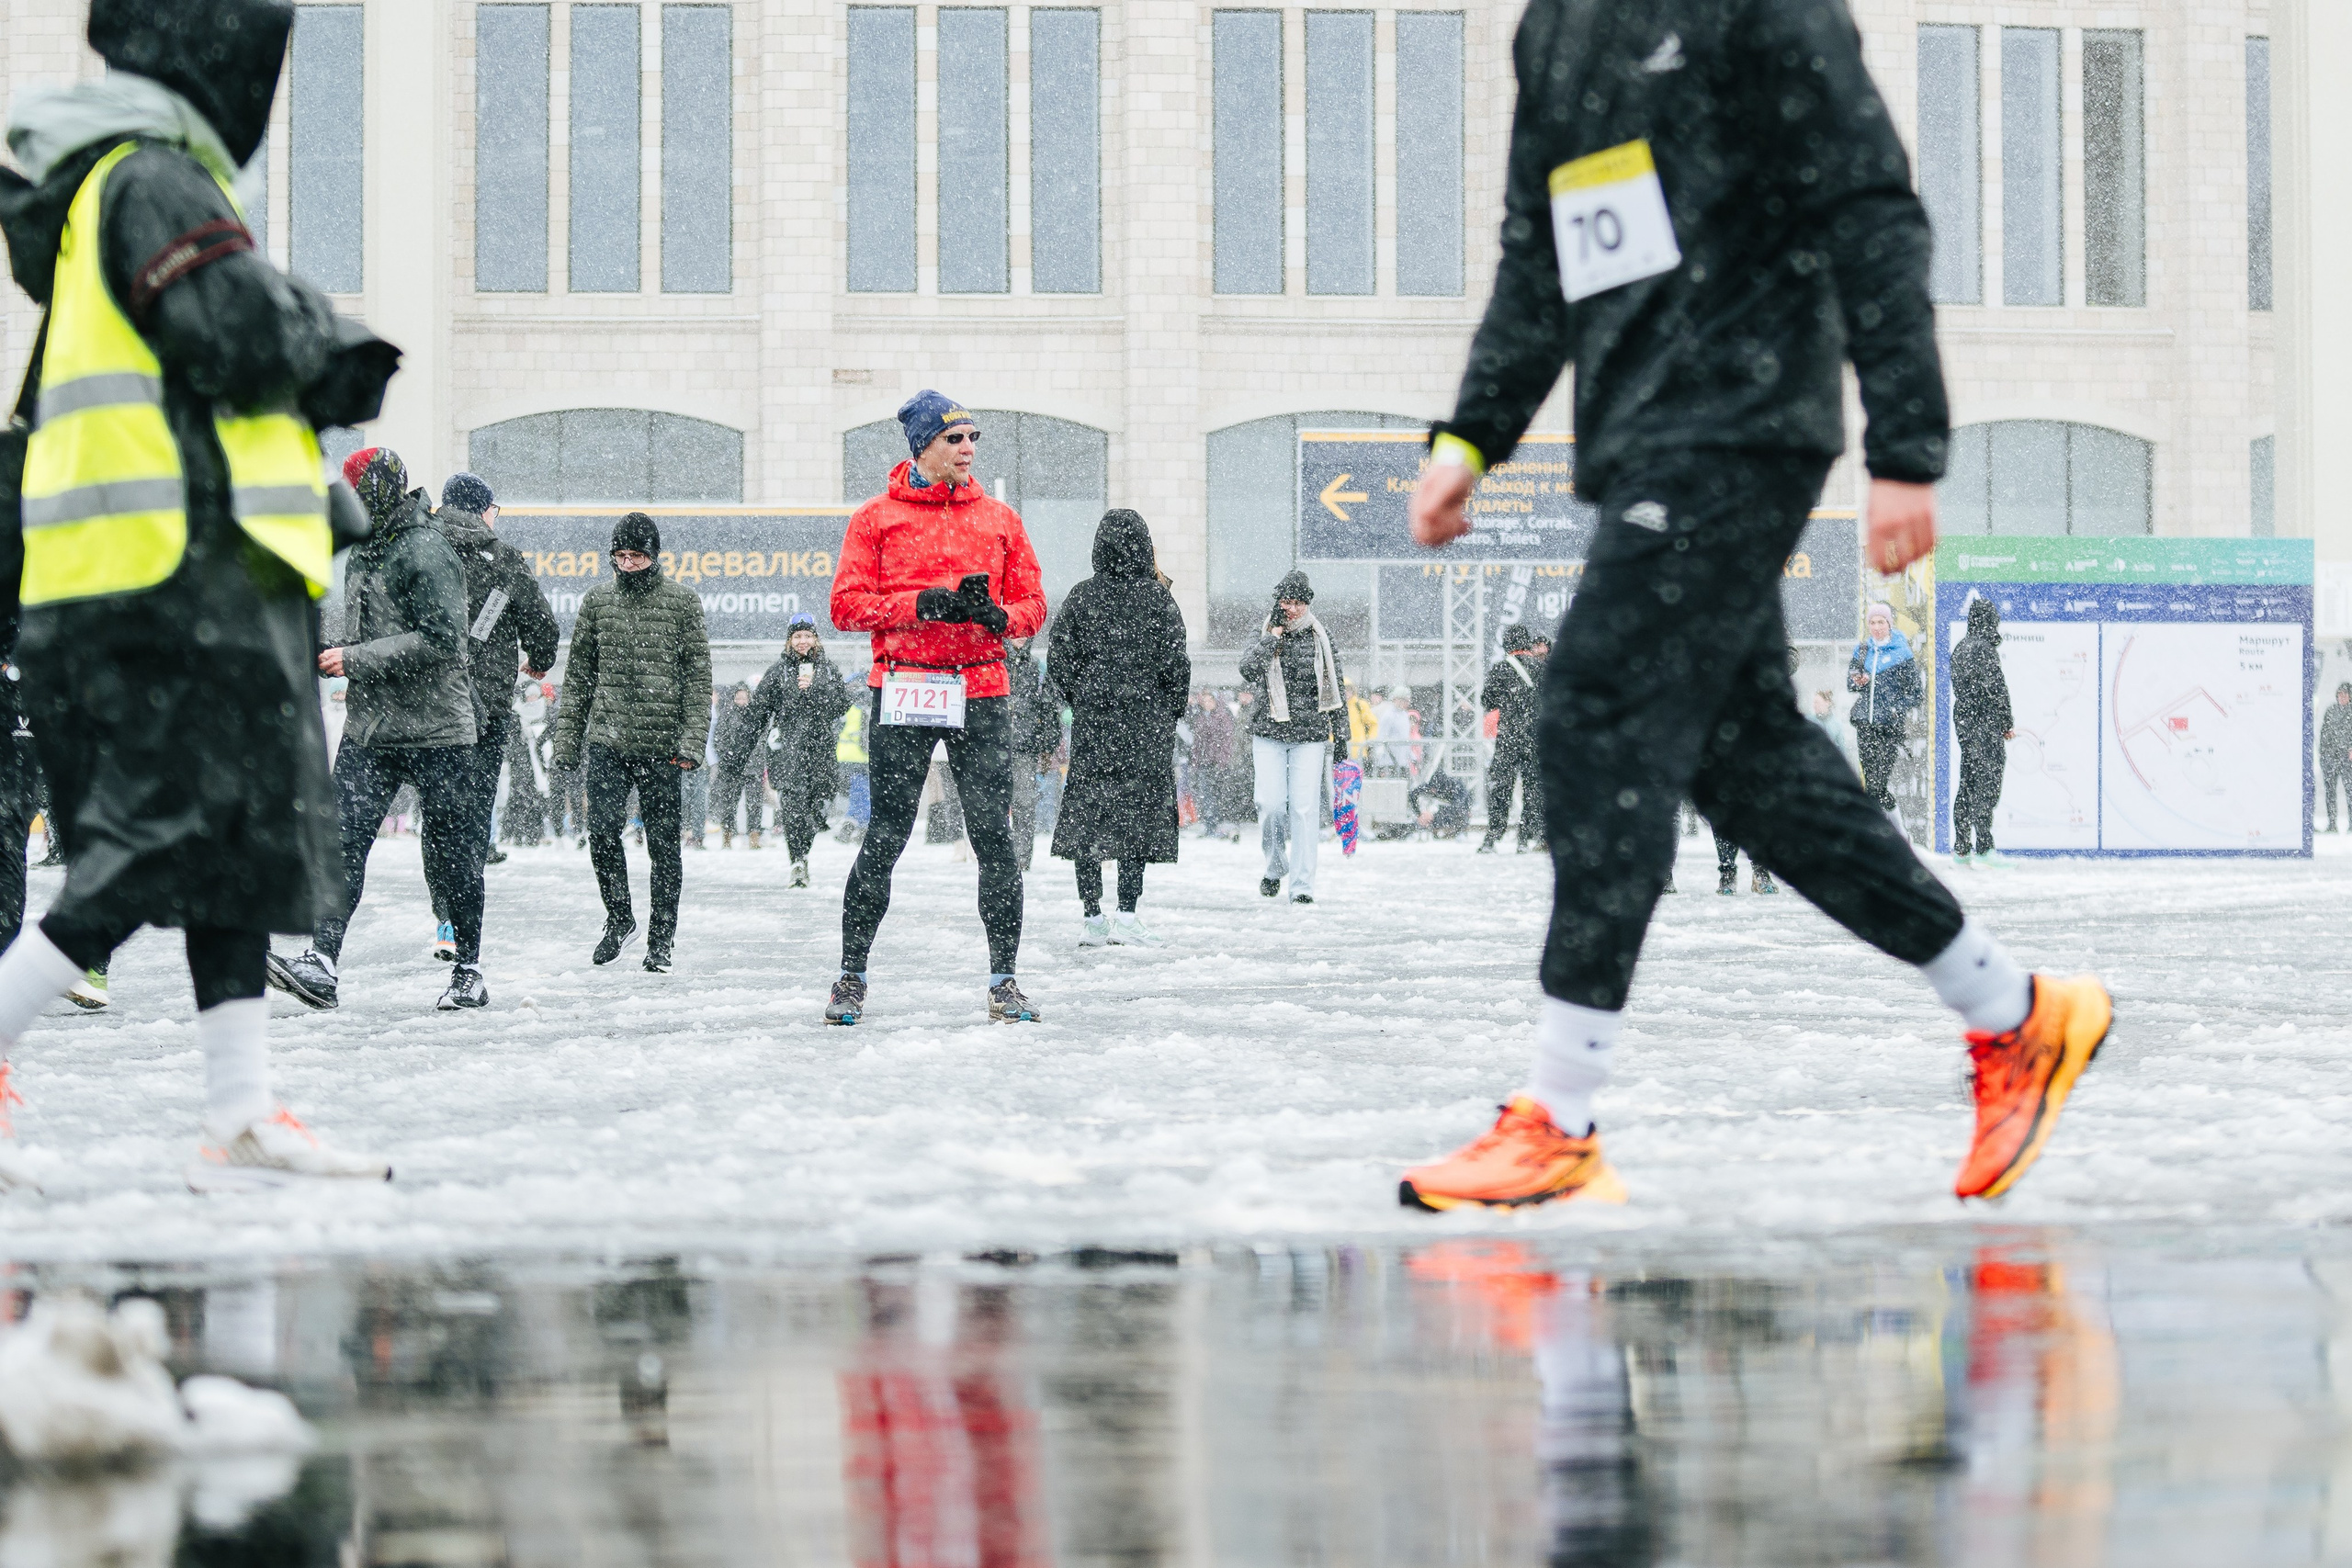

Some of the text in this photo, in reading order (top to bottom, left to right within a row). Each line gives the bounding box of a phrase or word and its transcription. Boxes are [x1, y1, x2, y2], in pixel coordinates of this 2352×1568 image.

[1570, 208, 1623, 265] 70
[1481, 477, 1535, 496] Выход
[1464, 497, 1532, 514] Туалеты
[1527, 515, 1577, 531] Corrals,
[1498, 532, 1541, 547] Toilets
[659, 551, 832, 583] здевалка
[701, 592, 799, 614] women
[2239, 636, 2290, 647] Маршрут
[895, 688, 947, 709] 7121
[894, 710, 902, 721] D
